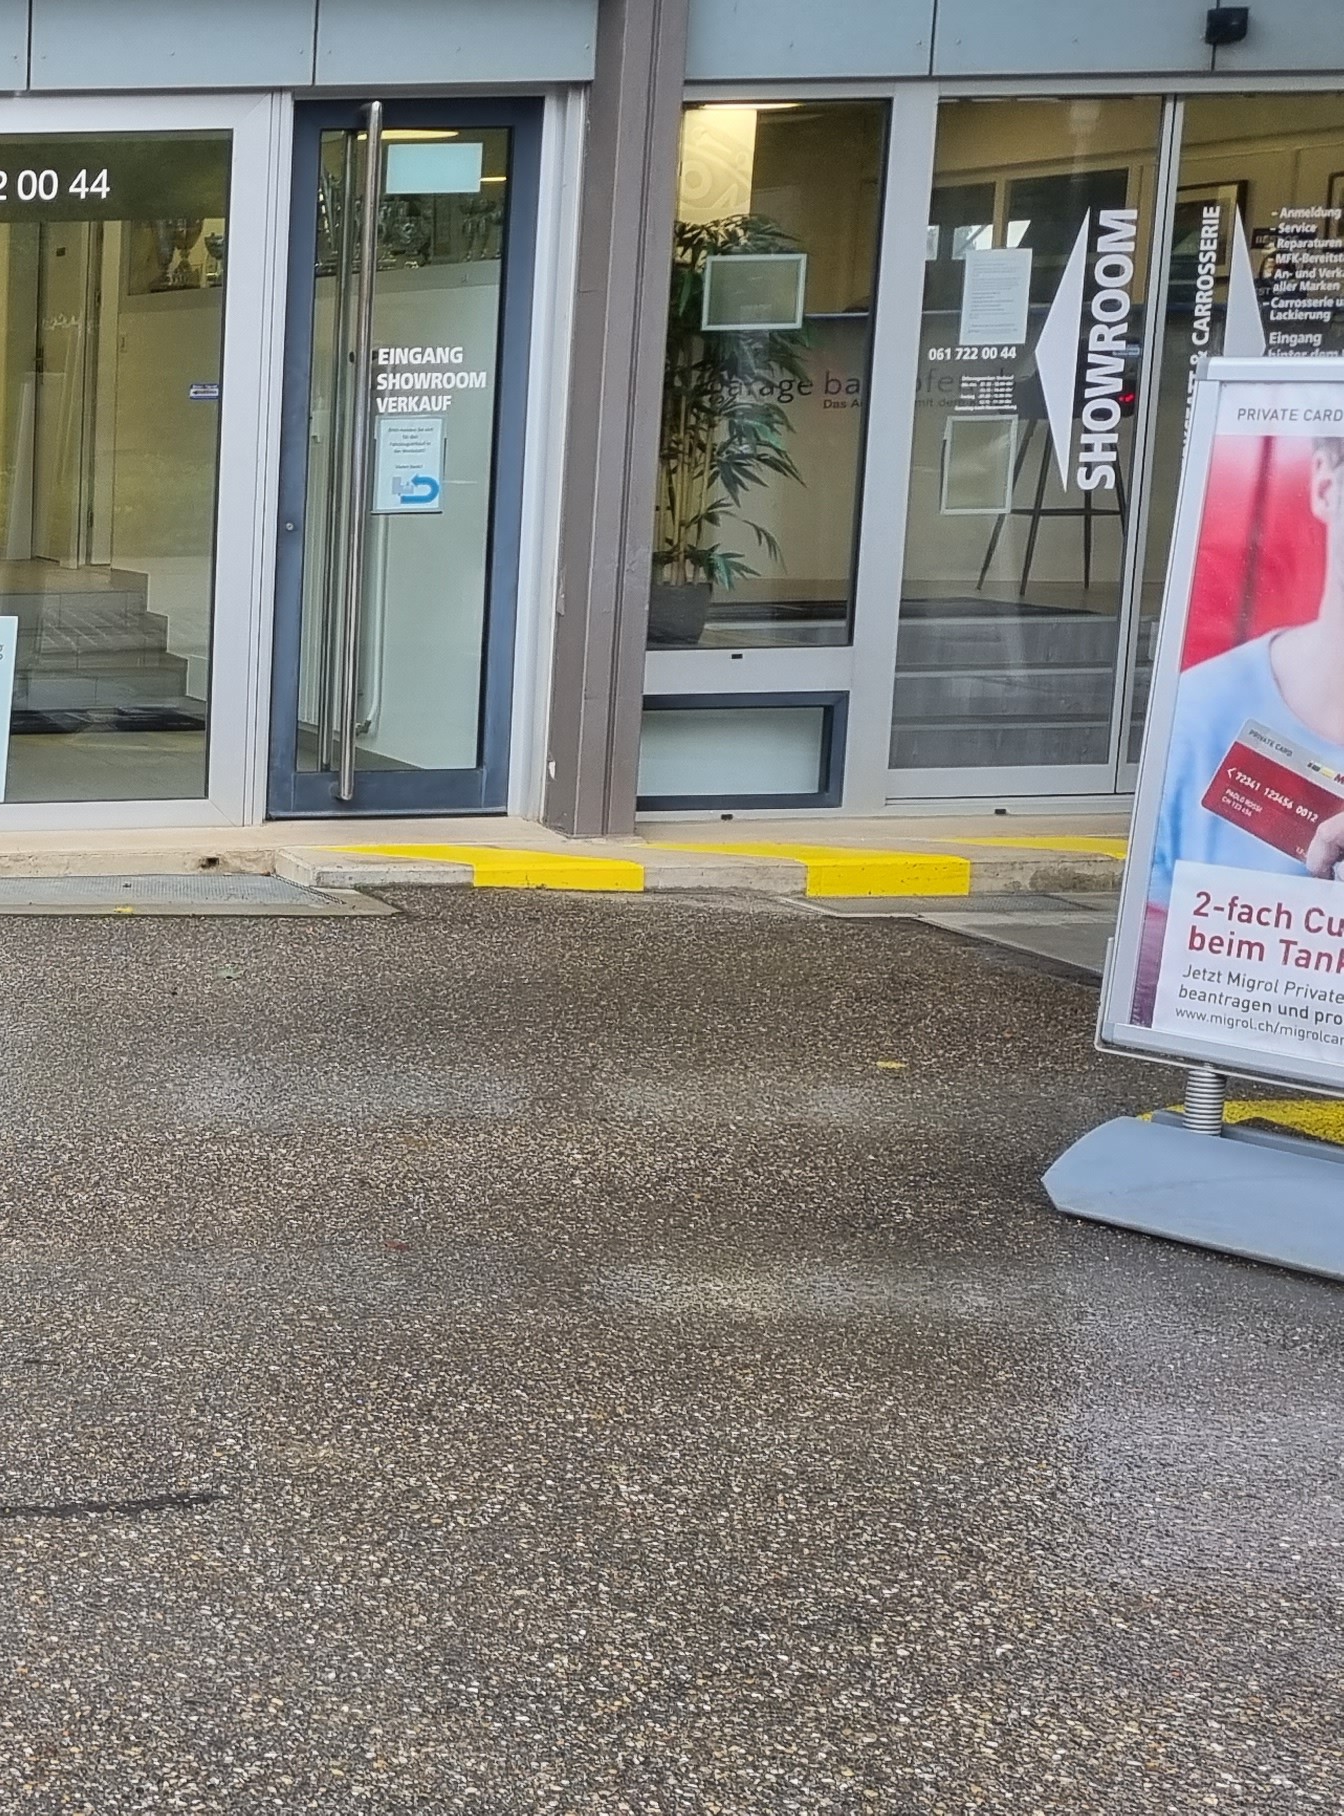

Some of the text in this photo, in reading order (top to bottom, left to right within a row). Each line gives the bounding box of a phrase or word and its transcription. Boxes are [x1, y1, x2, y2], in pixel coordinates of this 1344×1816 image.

[17, 169, 58, 201] 00
[68, 169, 110, 200] 44
[1280, 206, 1342, 220] Anmeldung
[1278, 222, 1317, 234] Service
[1277, 238, 1342, 252] Reparaturen
[1192, 205, 1220, 346] CARROSSERIE
[1295, 267, 1316, 278] und
[1272, 280, 1298, 292] aller
[1299, 280, 1341, 292] Marken
[1271, 296, 1334, 309] Carrosserie
[1270, 309, 1331, 322] Lackierung
[1269, 331, 1322, 347] Eingang
[378, 347, 463, 365] EINGANG
[928, 346, 1016, 360] 061 722 00 44
[1077, 209, 1138, 490] SHOWROOM
[376, 371, 487, 390] SHOWROOM
[376, 395, 452, 413] VERKAUF
[1237, 408, 1344, 422] PRIVATE CARD
[1248, 728, 1294, 757] PRIVATE CARD
[1192, 891, 1293, 930] 2-fach
[1188, 925, 1265, 962] beim
[1182, 964, 1344, 1005] Jetzt Migrol Private
[1178, 984, 1343, 1026] beantragen und pro
